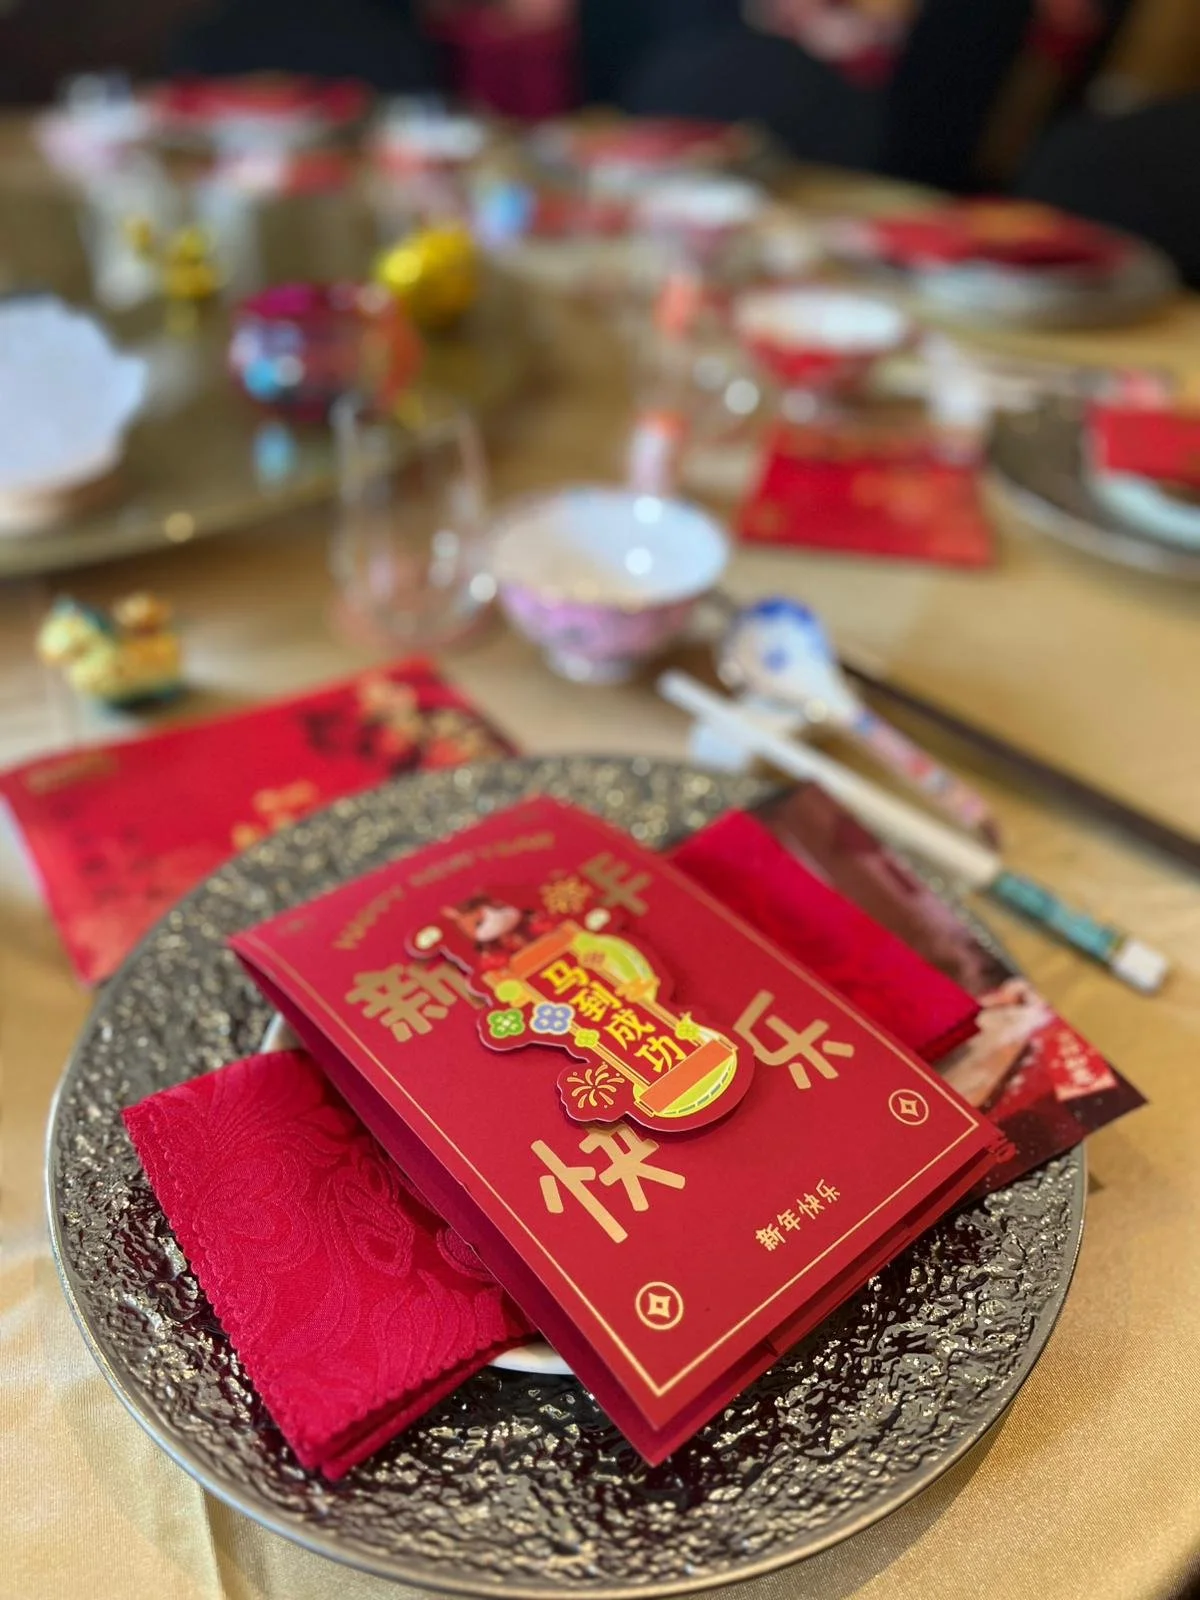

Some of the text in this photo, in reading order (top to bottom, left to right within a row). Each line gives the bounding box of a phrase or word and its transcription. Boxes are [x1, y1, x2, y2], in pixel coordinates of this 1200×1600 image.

[345, 963, 487, 1042] 新
[580, 851, 652, 917] 年
[540, 960, 688, 1073] 马到成功
[530, 989, 855, 1243] 快 乐
[755, 1179, 841, 1252] 新年快乐
